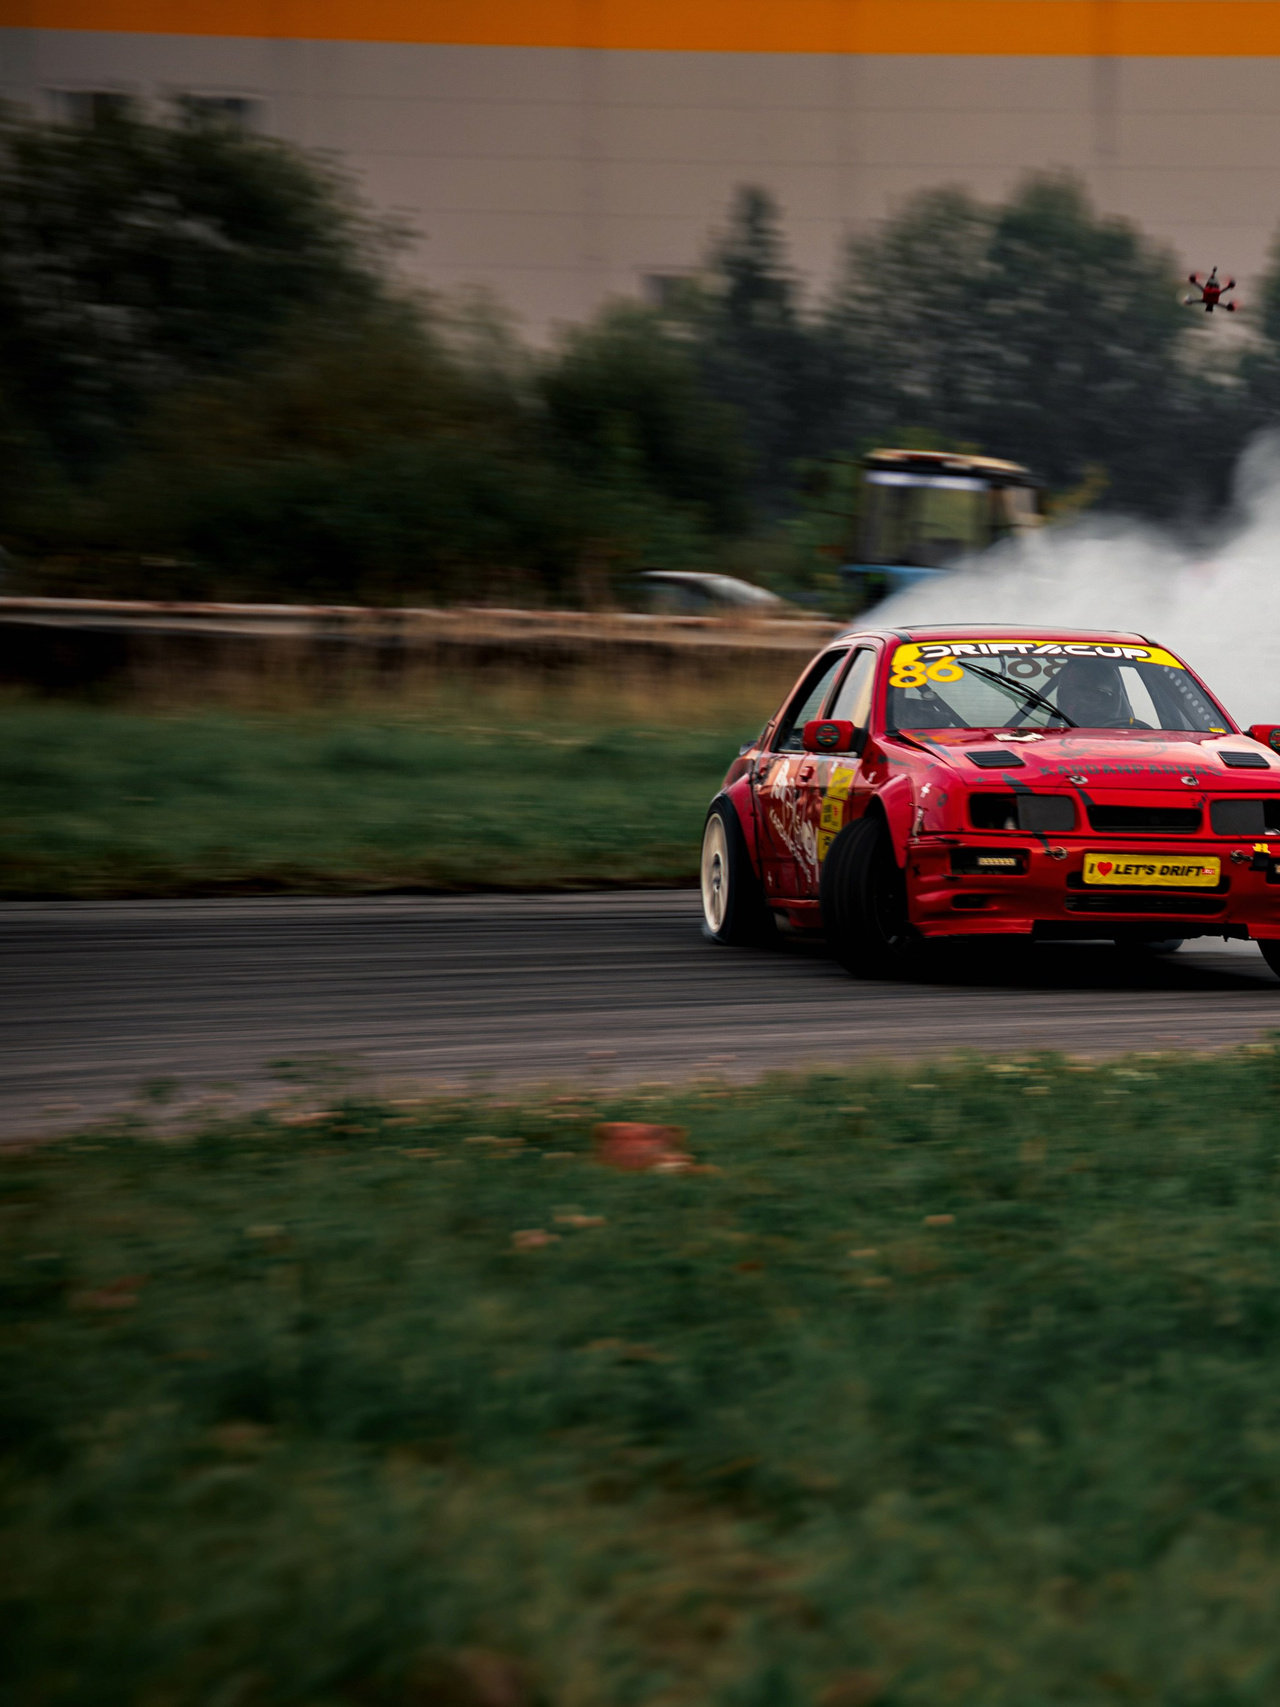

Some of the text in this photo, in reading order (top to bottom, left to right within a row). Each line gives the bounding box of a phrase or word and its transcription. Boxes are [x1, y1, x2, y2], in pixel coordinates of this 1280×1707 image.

[889, 656, 965, 689] 86
[1088, 863, 1096, 875] I
[1113, 863, 1157, 876] LET'S
